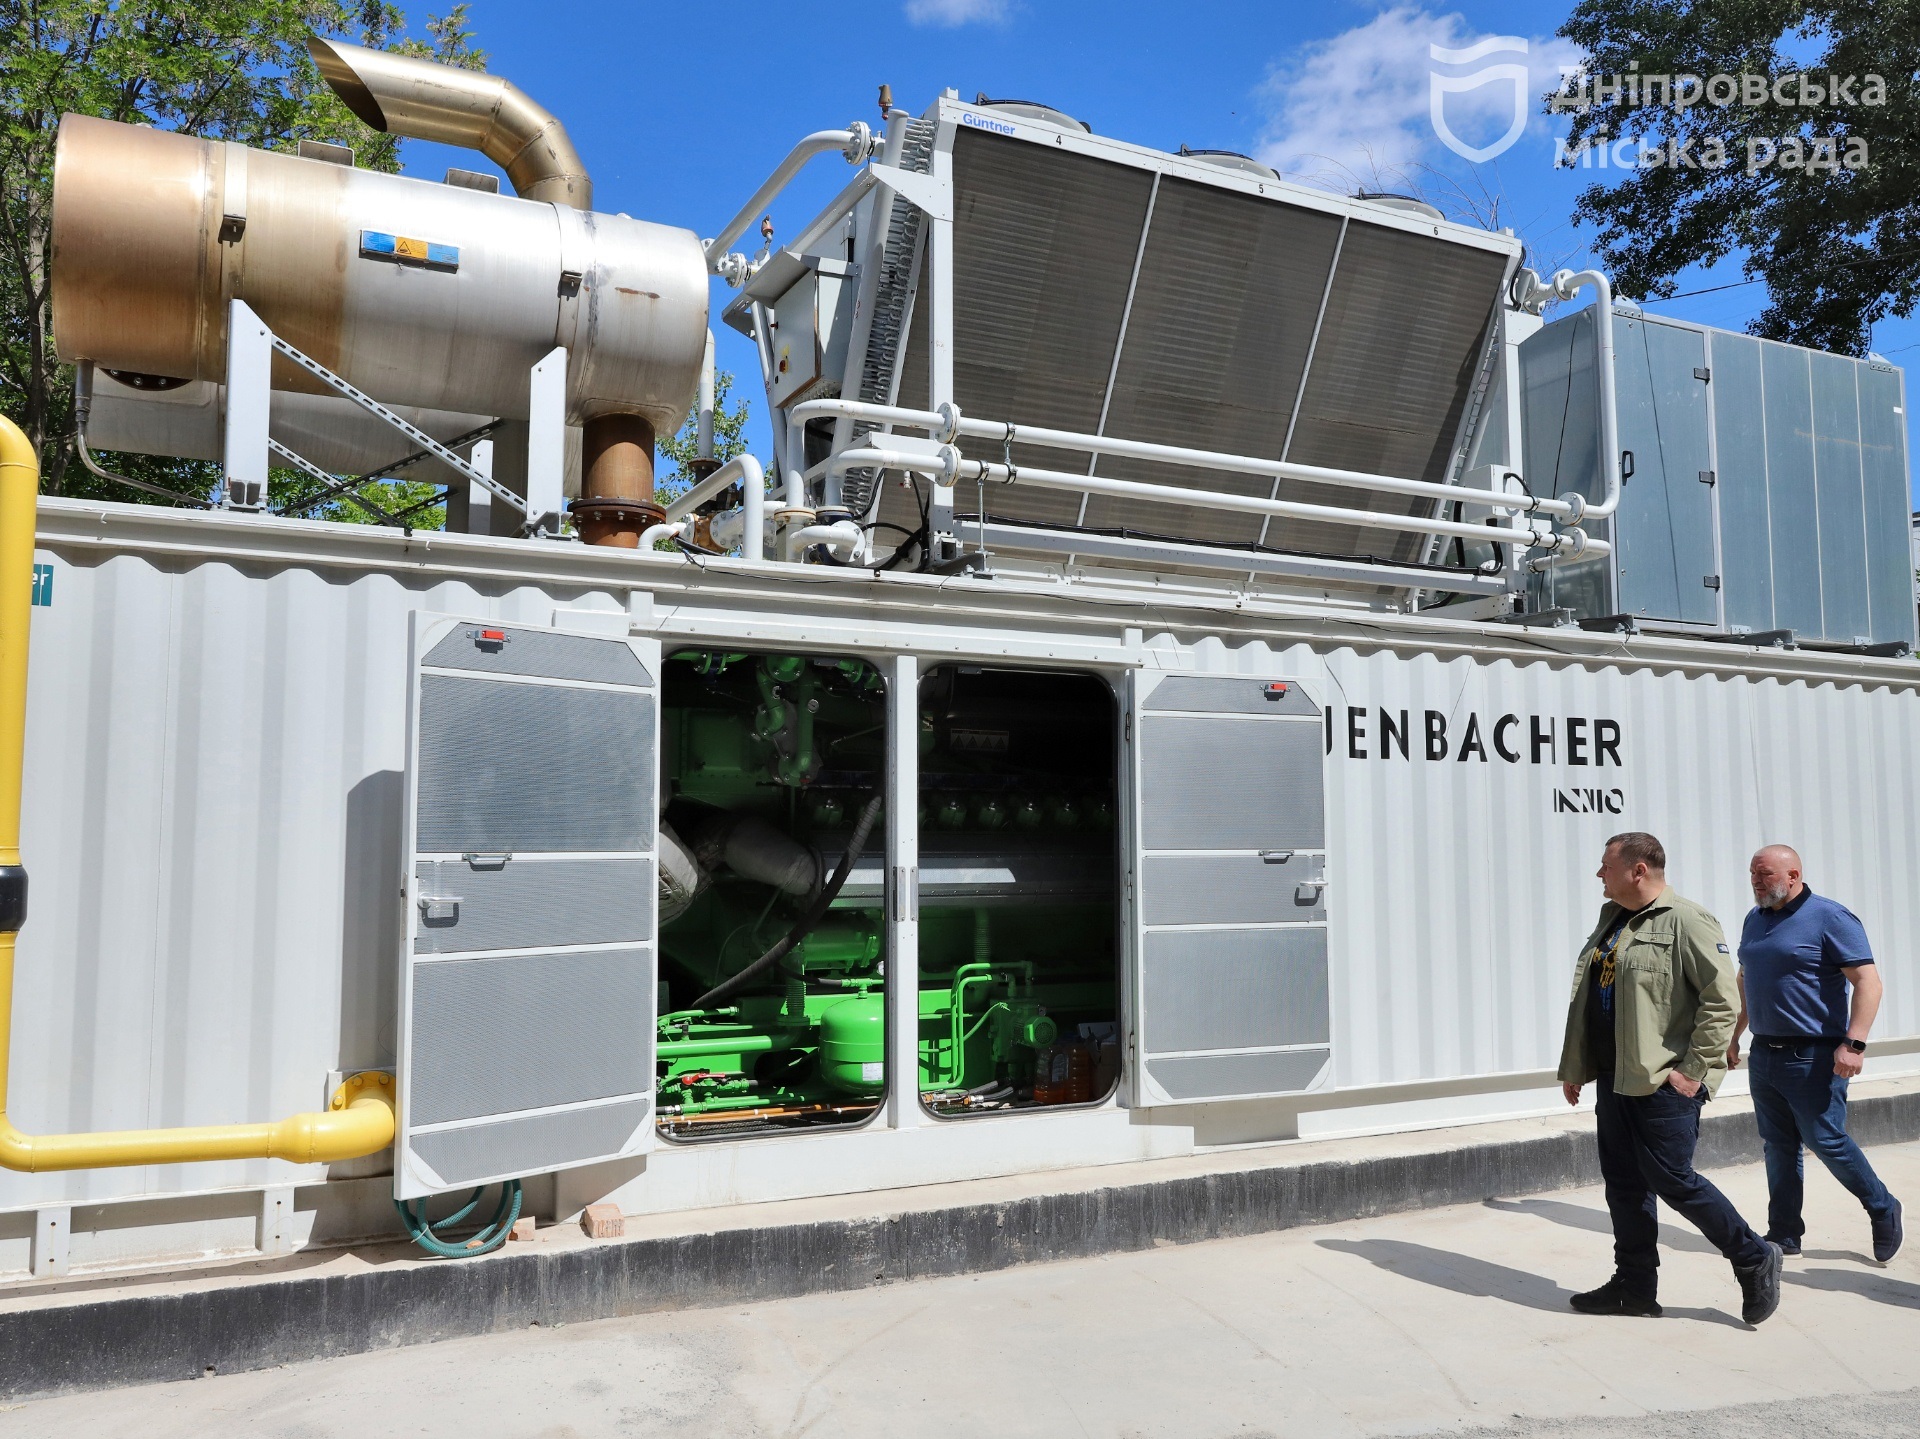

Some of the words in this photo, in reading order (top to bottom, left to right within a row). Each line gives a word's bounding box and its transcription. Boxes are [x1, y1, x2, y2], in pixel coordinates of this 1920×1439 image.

[962, 113, 1016, 135] Güntner
[1055, 134, 1062, 146] 4
[1258, 183, 1264, 194] 5
[1433, 226, 1439, 236] 6
[1553, 787, 1625, 815] INNIO
